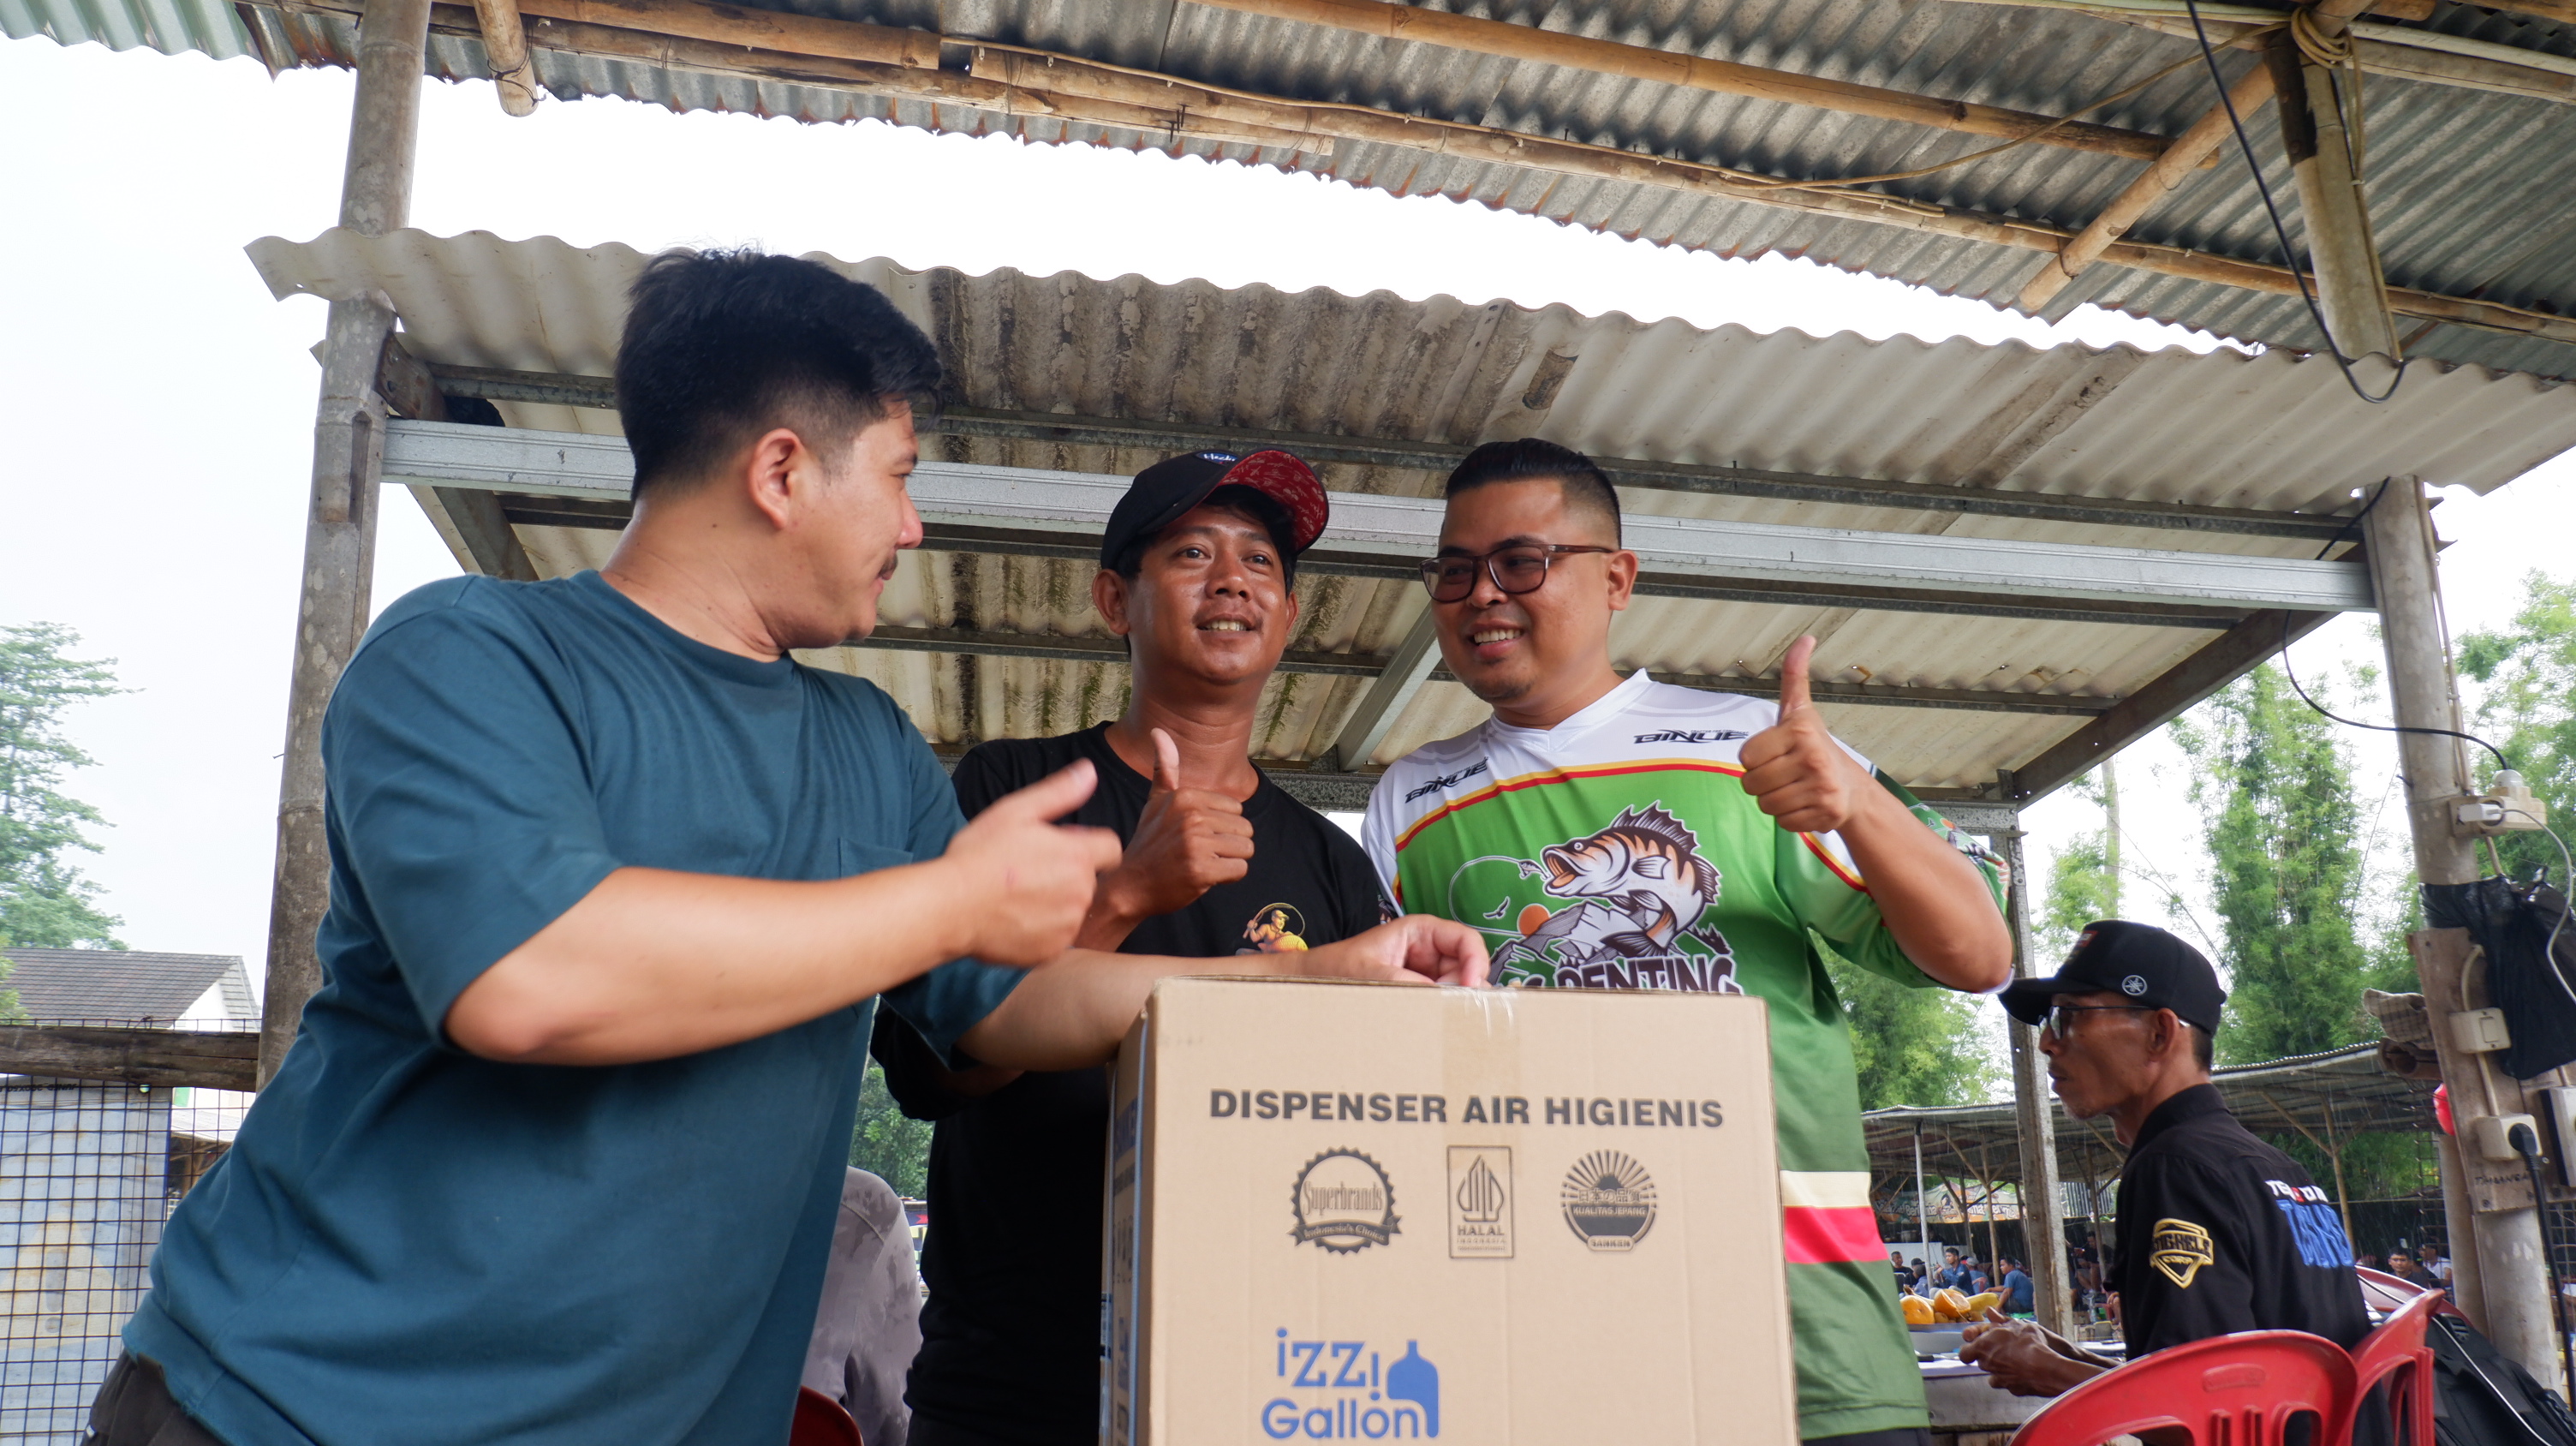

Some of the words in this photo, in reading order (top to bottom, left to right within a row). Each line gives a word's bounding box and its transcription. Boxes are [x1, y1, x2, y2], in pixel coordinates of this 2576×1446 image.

[1210, 1089, 1447, 1123] DISPENSER
[1462, 1096, 1530, 1124] AIR
[1545, 1097, 1723, 1127] HIGIENIS
[1302, 1181, 1383, 1216] Superbrands
[1573, 1206, 1614, 1216] KUALITAS
[1614, 1206, 1646, 1216] JEPANG
[1304, 1223, 1355, 1239] Indonesia's
[1355, 1224, 1386, 1241] Choice
[1457, 1224, 1505, 1236] HALAL
[1261, 1397, 1418, 1440] Gallon
